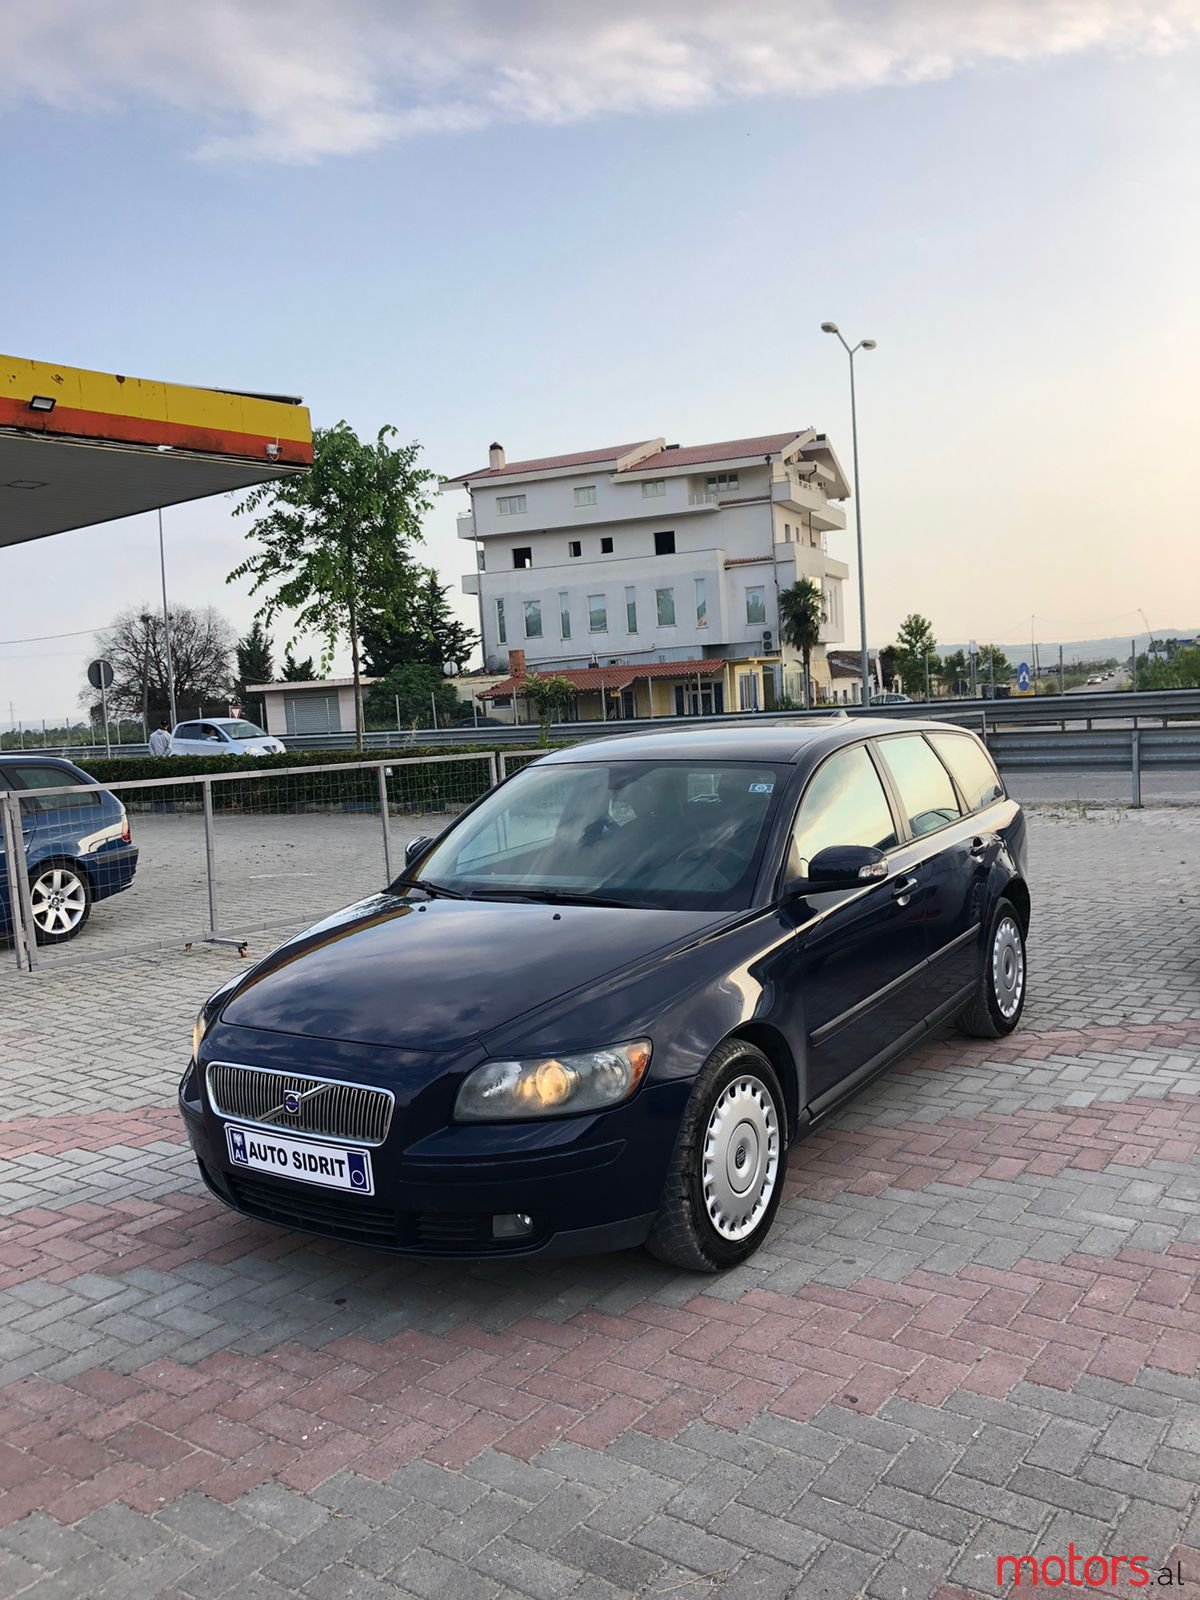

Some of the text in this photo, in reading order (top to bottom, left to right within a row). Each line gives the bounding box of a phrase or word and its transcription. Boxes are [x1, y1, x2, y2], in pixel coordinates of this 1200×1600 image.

[235, 1149, 247, 1162] AL
[249, 1142, 345, 1177] AUTO SIDRIT
